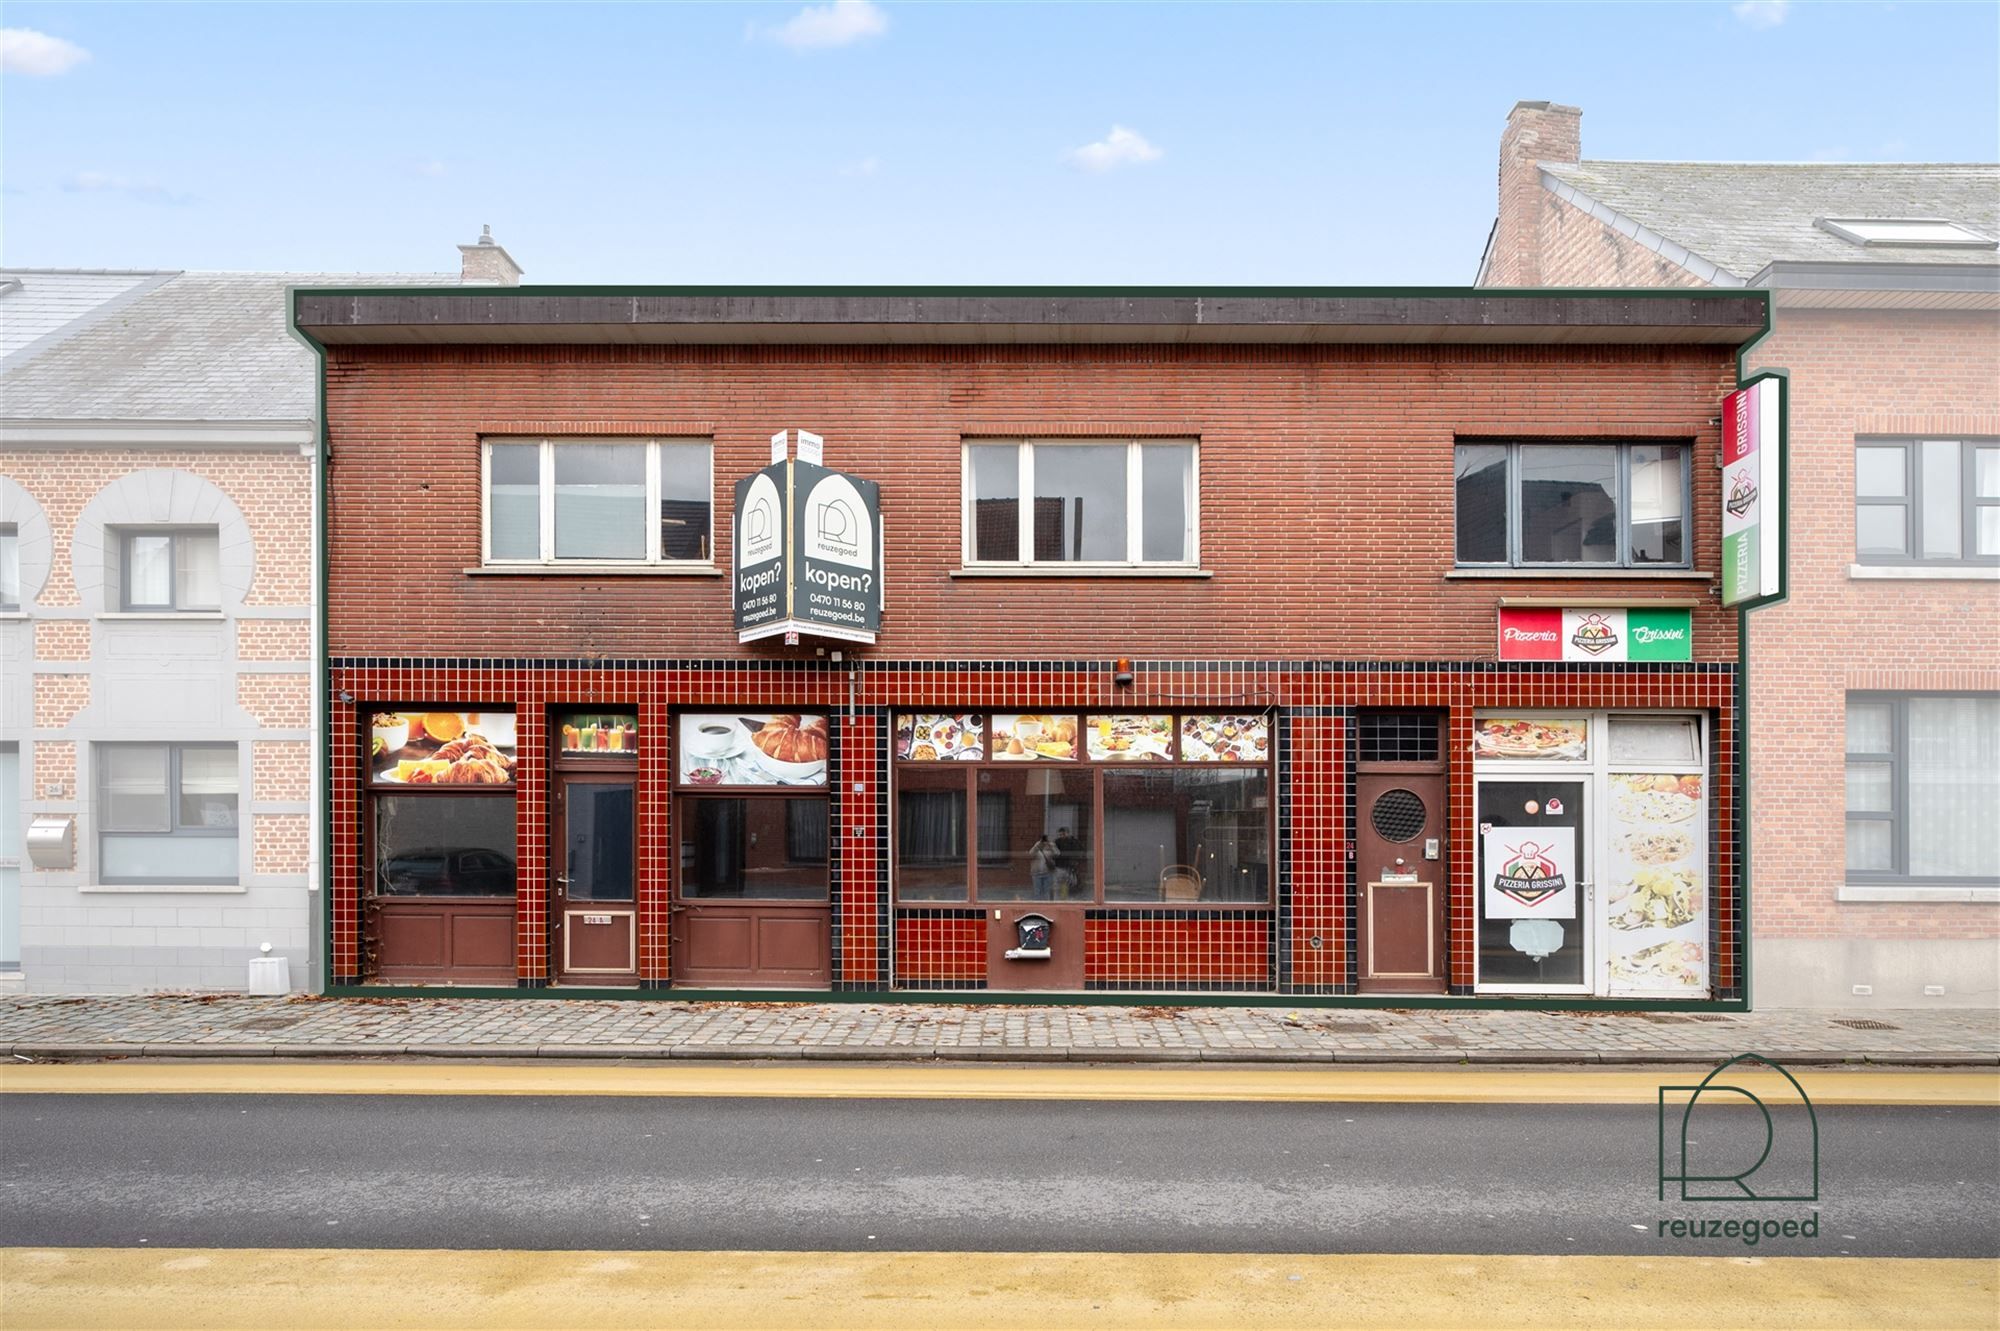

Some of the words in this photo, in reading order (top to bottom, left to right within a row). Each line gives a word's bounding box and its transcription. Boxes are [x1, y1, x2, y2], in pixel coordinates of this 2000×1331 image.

[1736, 391, 1748, 455] GRISSINI
[817, 543, 858, 557] reuzegoed
[1736, 532, 1748, 595] PIZZERIA
[740, 561, 782, 594] kopen?
[805, 561, 872, 593] kopen?
[742, 599, 756, 611] 0470
[756, 597, 761, 607] 11
[762, 595, 769, 606] 56
[769, 593, 777, 604] 80
[810, 593, 832, 605] 0470
[833, 597, 840, 607] 11
[842, 599, 852, 609] 56
[853, 601, 865, 611] 80
[742, 607, 776, 623] reuzegoed.be
[810, 607, 865, 623] reuzegoed.be
[1503, 627, 1558, 642] Pizzeria
[1346, 841, 1354, 849] 24
[1498, 878, 1530, 889] PIZZERIA
[1531, 878, 1563, 889] GRISSINI
